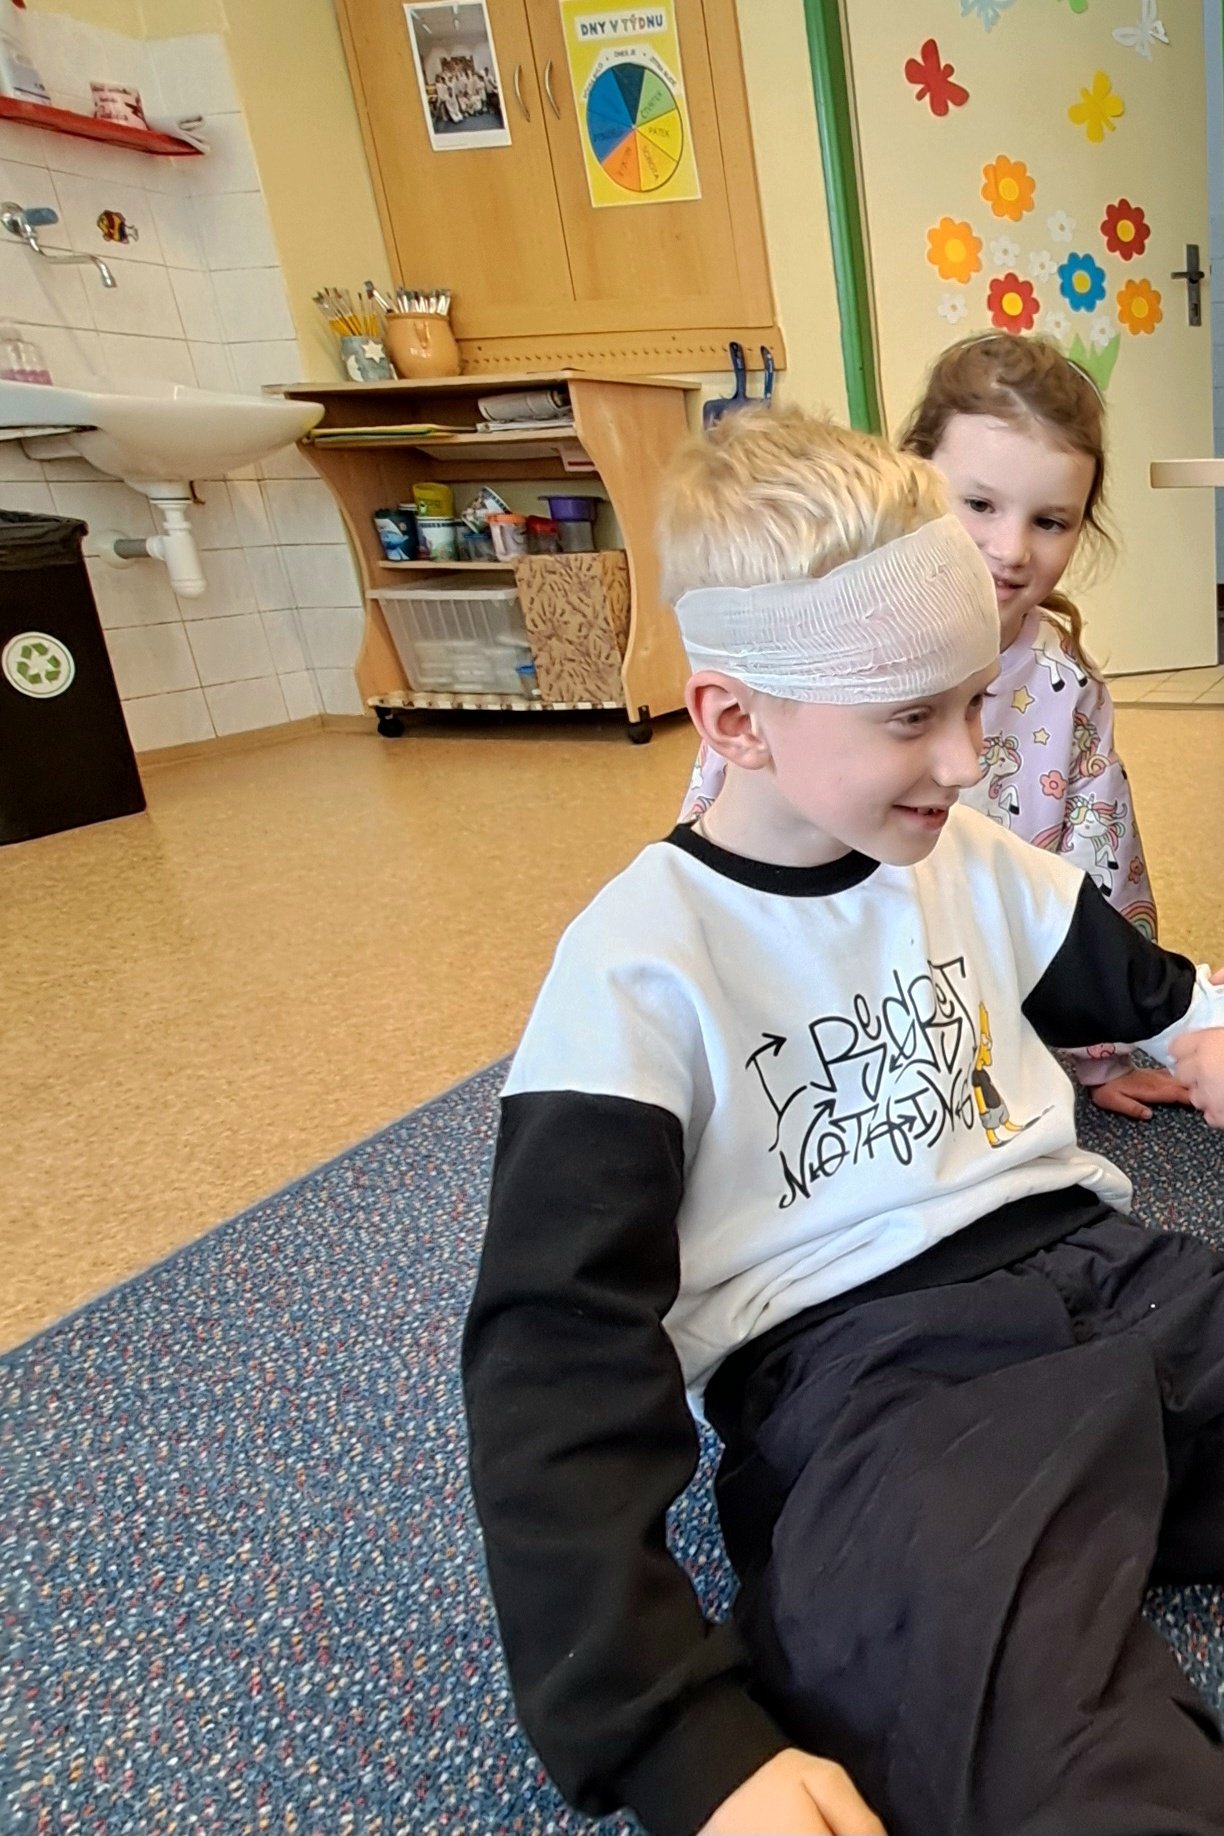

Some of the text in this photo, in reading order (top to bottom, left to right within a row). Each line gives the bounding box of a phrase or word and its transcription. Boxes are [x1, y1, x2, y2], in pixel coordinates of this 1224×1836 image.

[580, 14, 663, 36] DNY V TÝDNU
